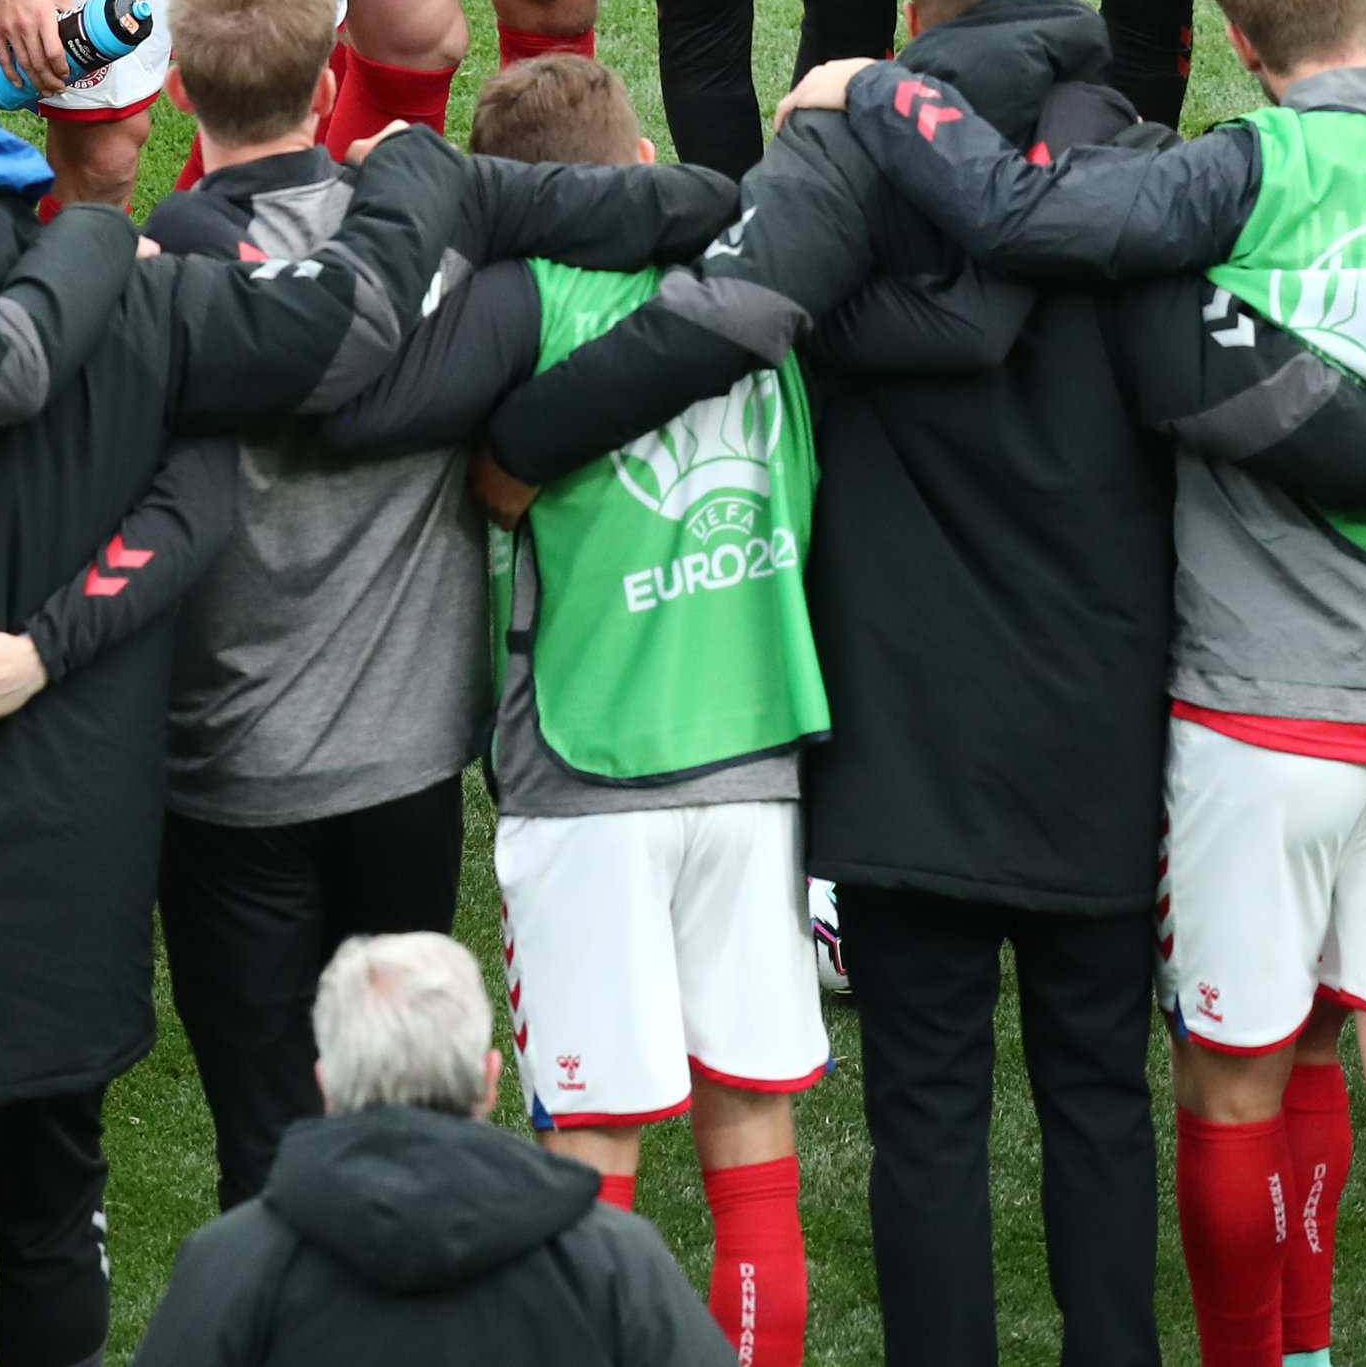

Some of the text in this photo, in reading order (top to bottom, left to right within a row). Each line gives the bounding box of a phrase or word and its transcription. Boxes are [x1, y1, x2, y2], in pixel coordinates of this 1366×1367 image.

[74, 80, 94, 89] 889
[691, 503, 754, 540] UEFA
[1302, 1162, 1324, 1254] DANMARK
[738, 1262, 756, 1367] DANMAR
